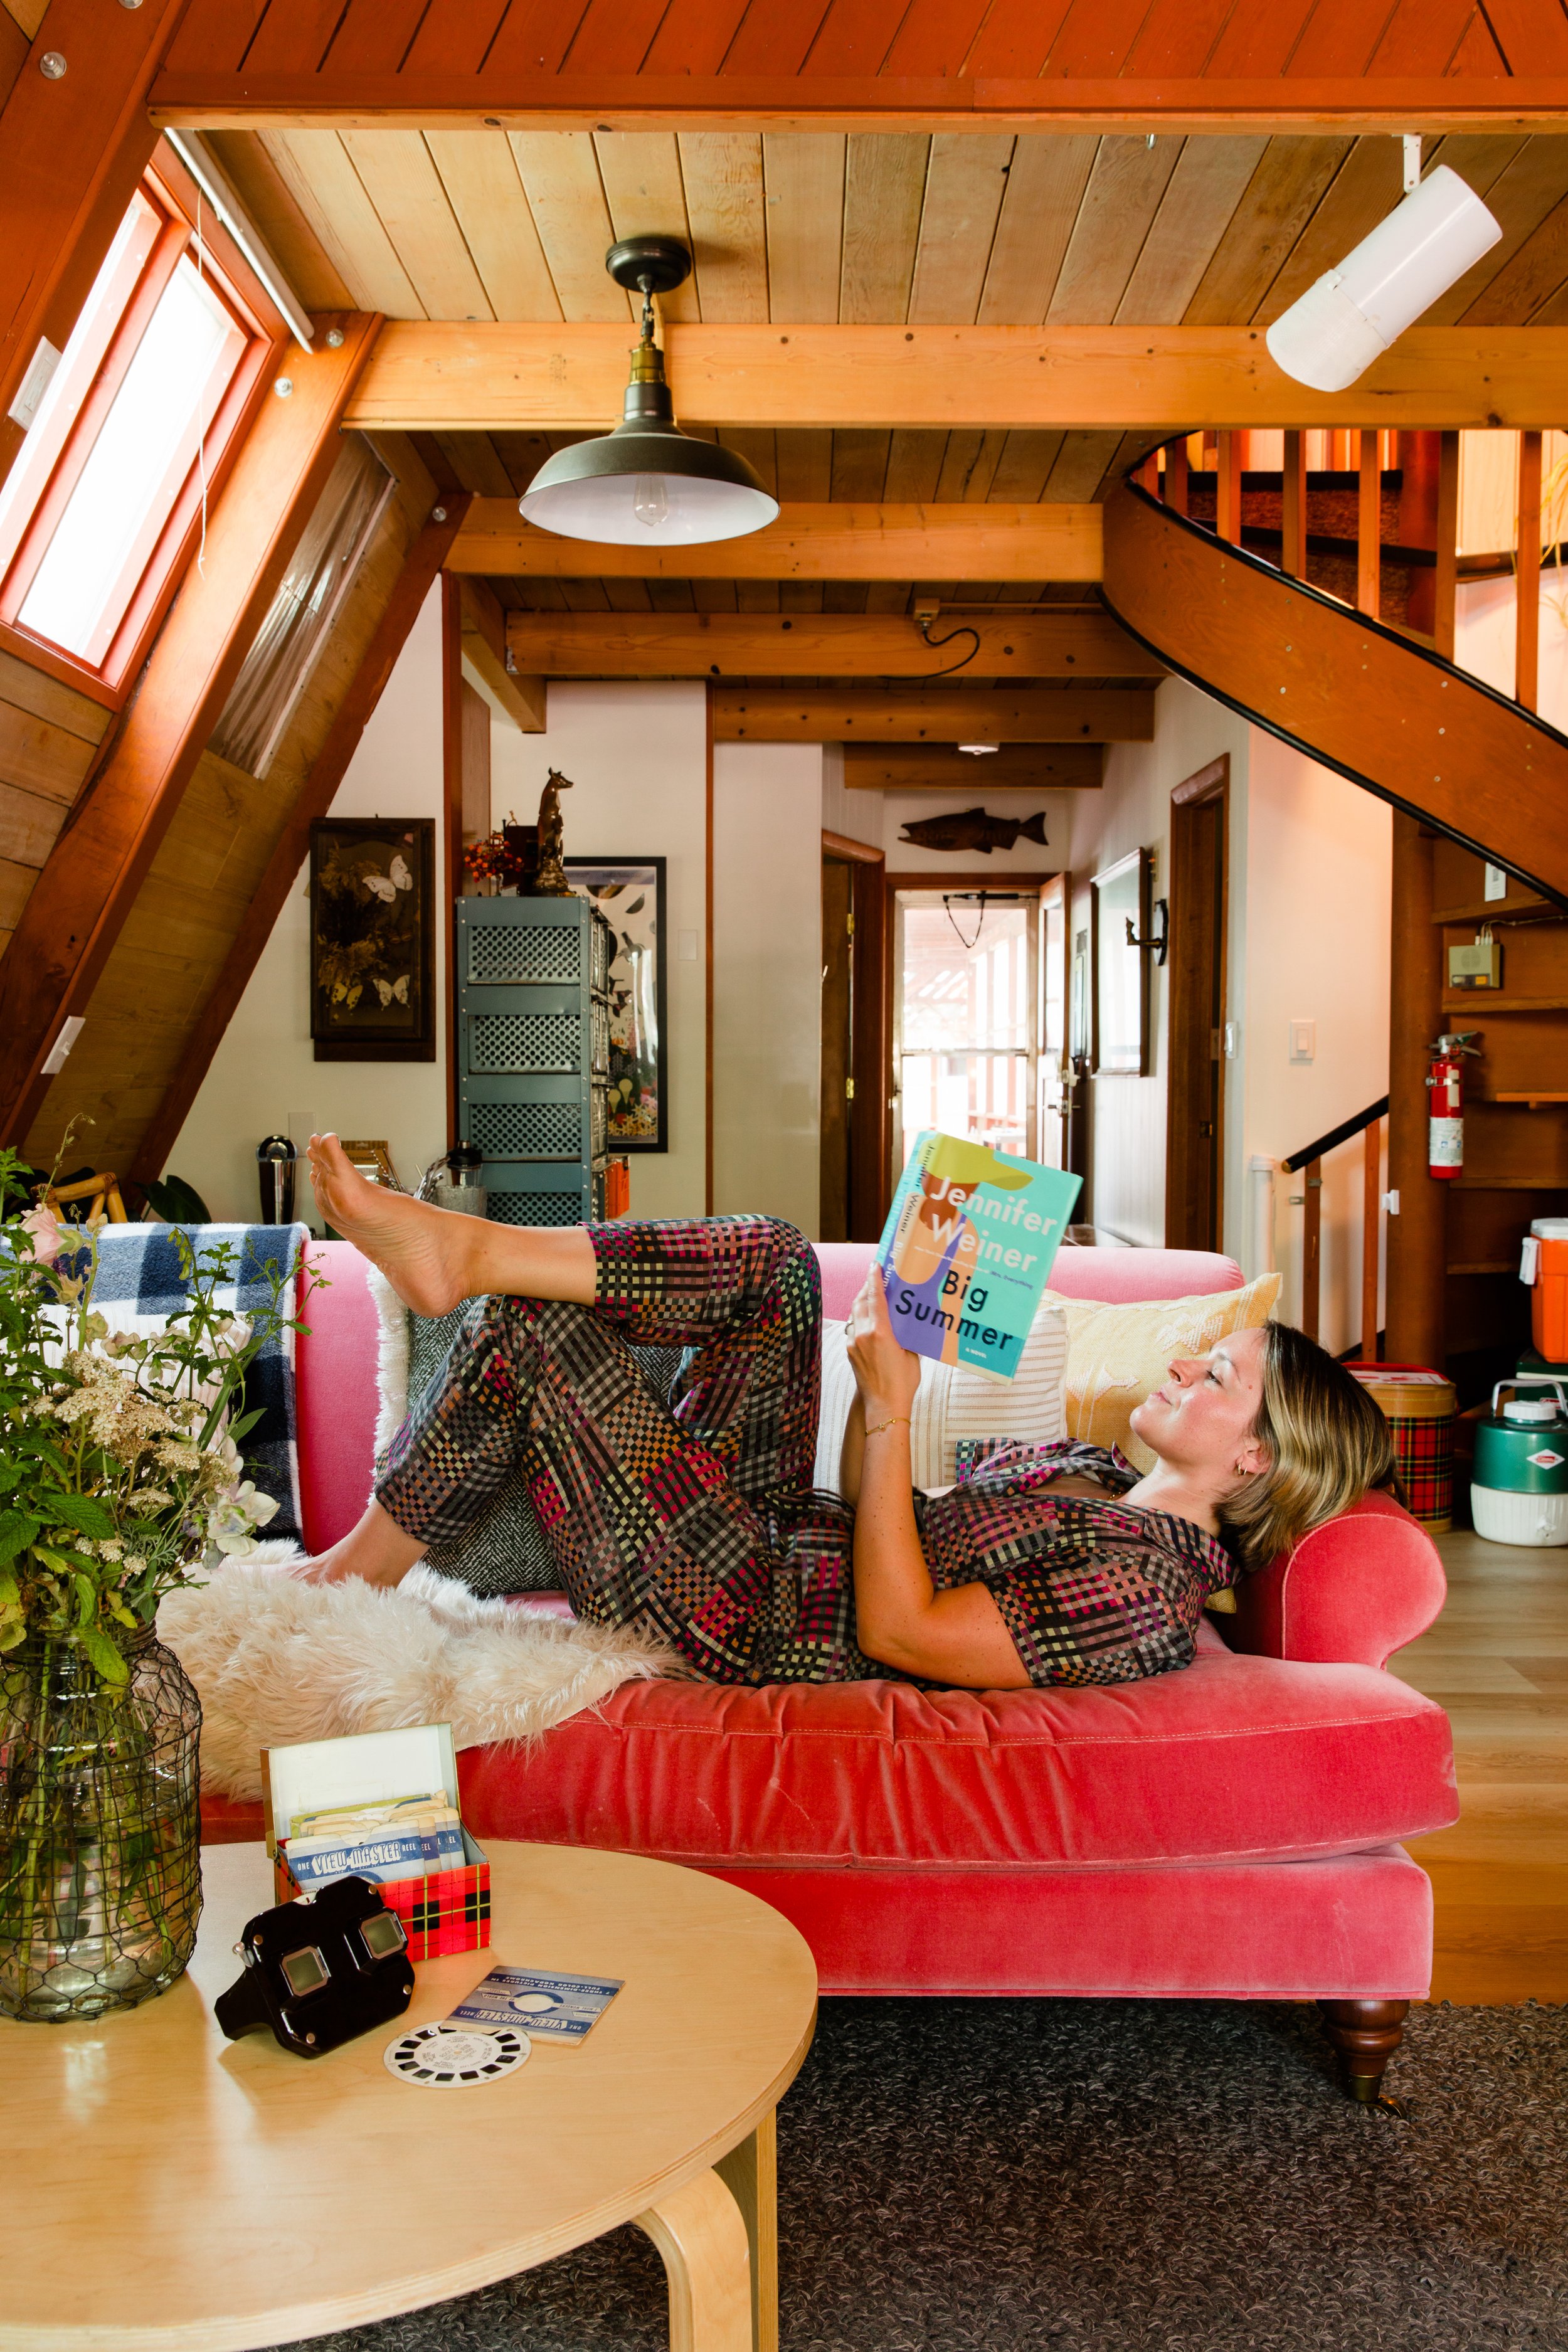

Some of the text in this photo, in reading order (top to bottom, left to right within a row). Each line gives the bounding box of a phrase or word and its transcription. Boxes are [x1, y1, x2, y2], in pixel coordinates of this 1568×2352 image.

[883, 1143, 935, 1290] Jennifer Weiner Big Sum
[930, 1177, 1058, 1236] Jennifer
[932, 1214, 1038, 1273] Weiner
[942, 1269, 988, 1313] Big
[895, 1290, 1013, 1350] Summer
[421, 1844, 432, 1853] EEL
[448, 1836, 457, 1844] EL
[297, 1862, 310, 1871] ONE
[312, 1841, 401, 1875] VIEW-MASTER
[402, 1843, 416, 1852] REEL
[502, 1979, 534, 1987] PICTURES
[506, 1976, 600, 1991] FULL-COLOR KODACHROME
[538, 1983, 603, 1994] THREE-DIMENSION
[474, 2009, 568, 2030] VIEW-MASTER
